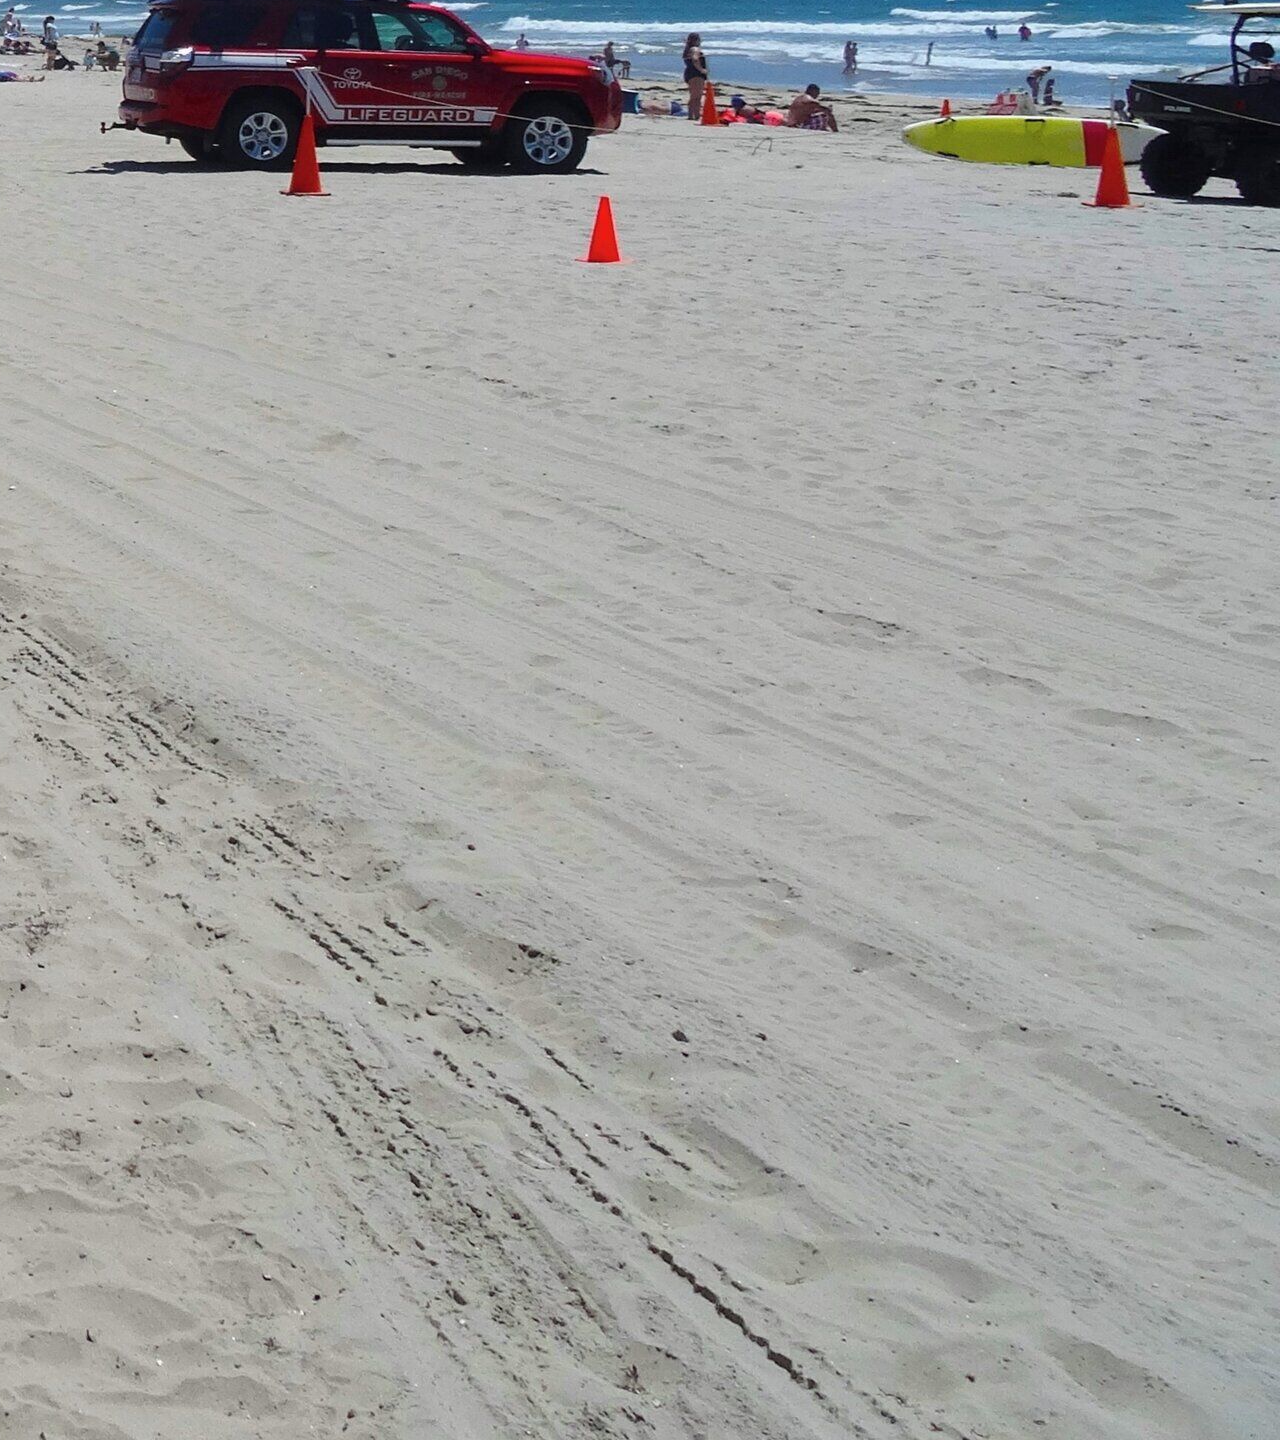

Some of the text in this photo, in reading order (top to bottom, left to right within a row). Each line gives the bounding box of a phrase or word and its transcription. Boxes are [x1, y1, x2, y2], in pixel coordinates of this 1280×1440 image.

[411, 65, 469, 81] SAN DIEGO
[332, 80, 372, 89] TOYOTA
[347, 110, 471, 122] LIFEGUARD
